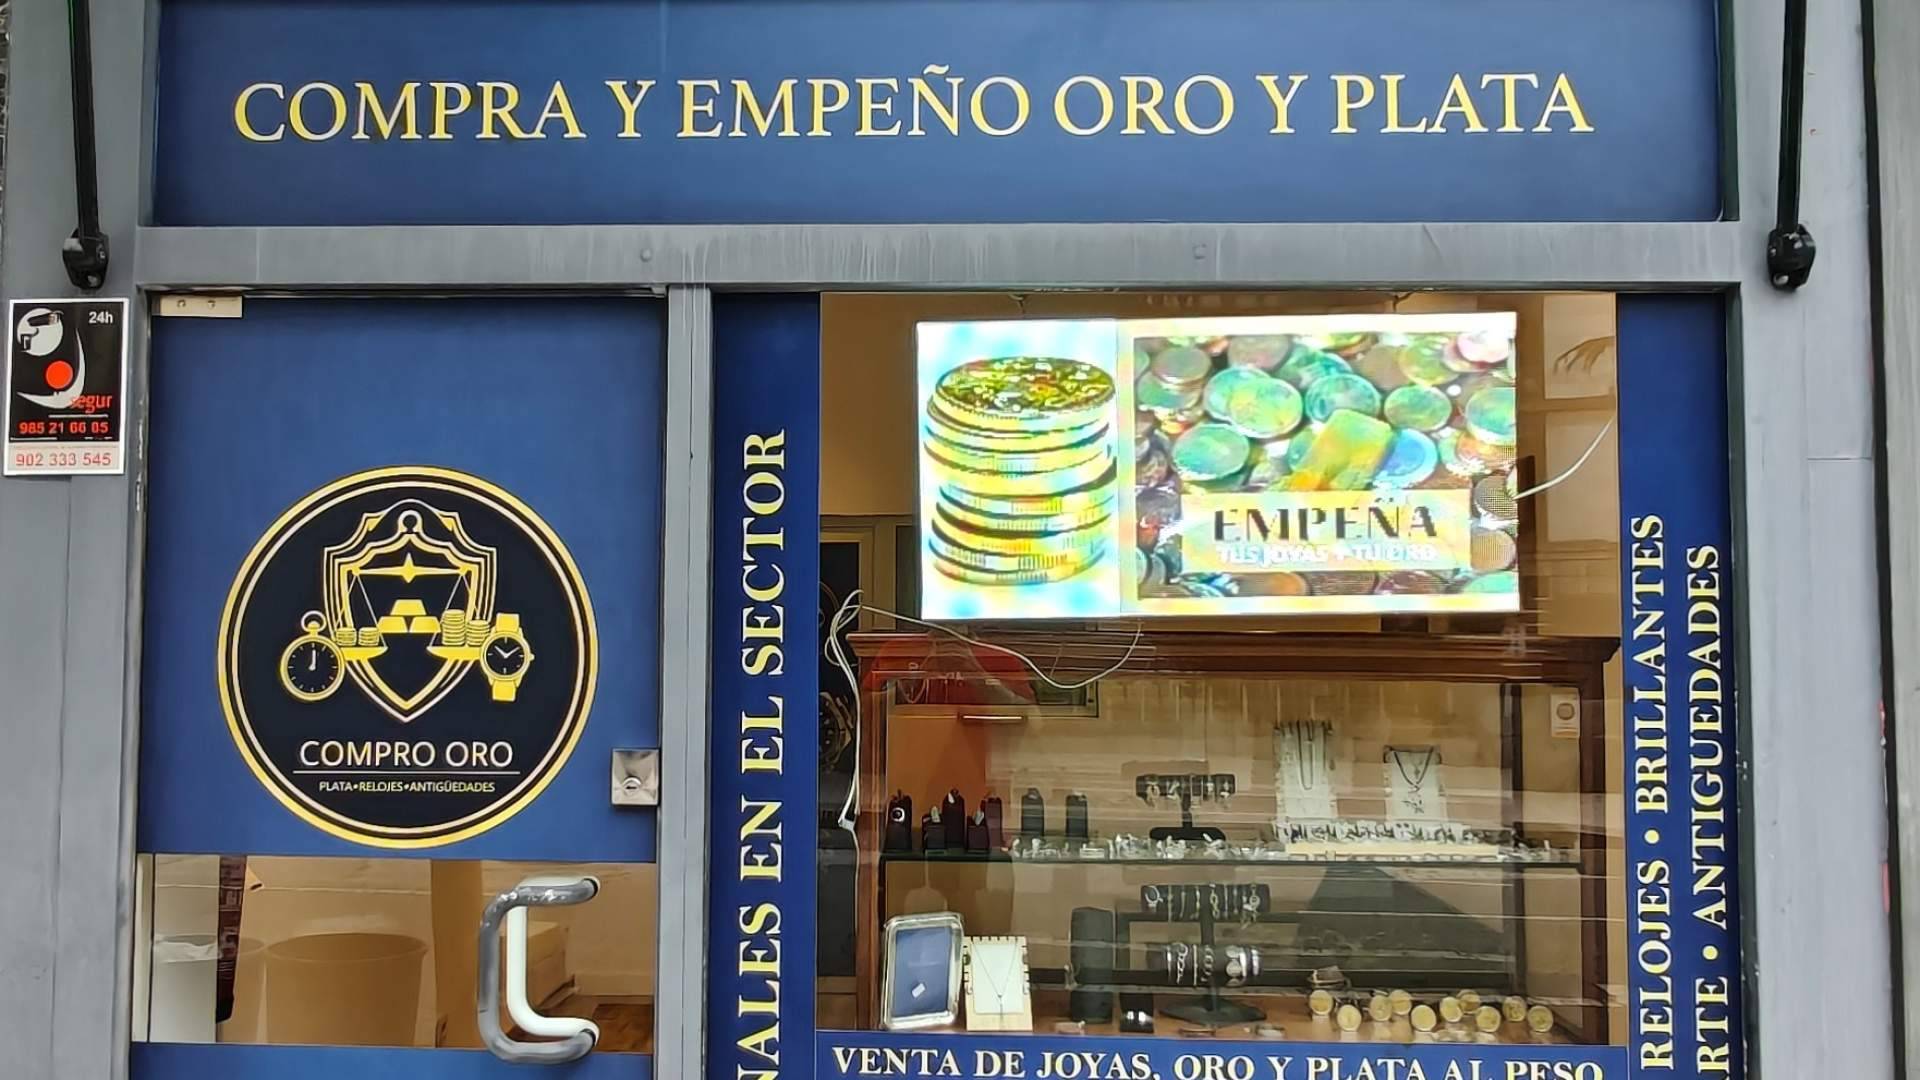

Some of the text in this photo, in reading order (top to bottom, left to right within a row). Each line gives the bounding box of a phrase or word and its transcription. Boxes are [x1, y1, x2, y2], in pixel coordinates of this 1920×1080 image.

[234, 65, 1595, 141] COMPRA Y EMPEÑO ORO Y PLATA
[88, 311, 114, 324] 24h
[19, 422, 45, 434] 985
[48, 422, 64, 434] 21
[91, 422, 109, 433] 05
[16, 453, 111, 466] 902 333 545
[1214, 498, 1437, 541] EMPEÑA
[741, 430, 785, 676] SECTOR
[299, 740, 513, 768] COMPRO ORO
[741, 696, 783, 775] EL
[1631, 516, 1674, 1070] RELOJES BRILLANTES
[1687, 546, 1730, 1080] RTE ANTIGUEDADES
[740, 795, 782, 883] EN
[832, 1047, 962, 1077] VENTA
[973, 1050, 1026, 1078] DE
[1173, 1055, 1255, 1080] ORO
[1266, 1056, 1293, 1080] Y
[1305, 1056, 1427, 1080] PLATA
[1444, 1059, 1493, 1080] AL
[1504, 1060, 1604, 1080] PESO
